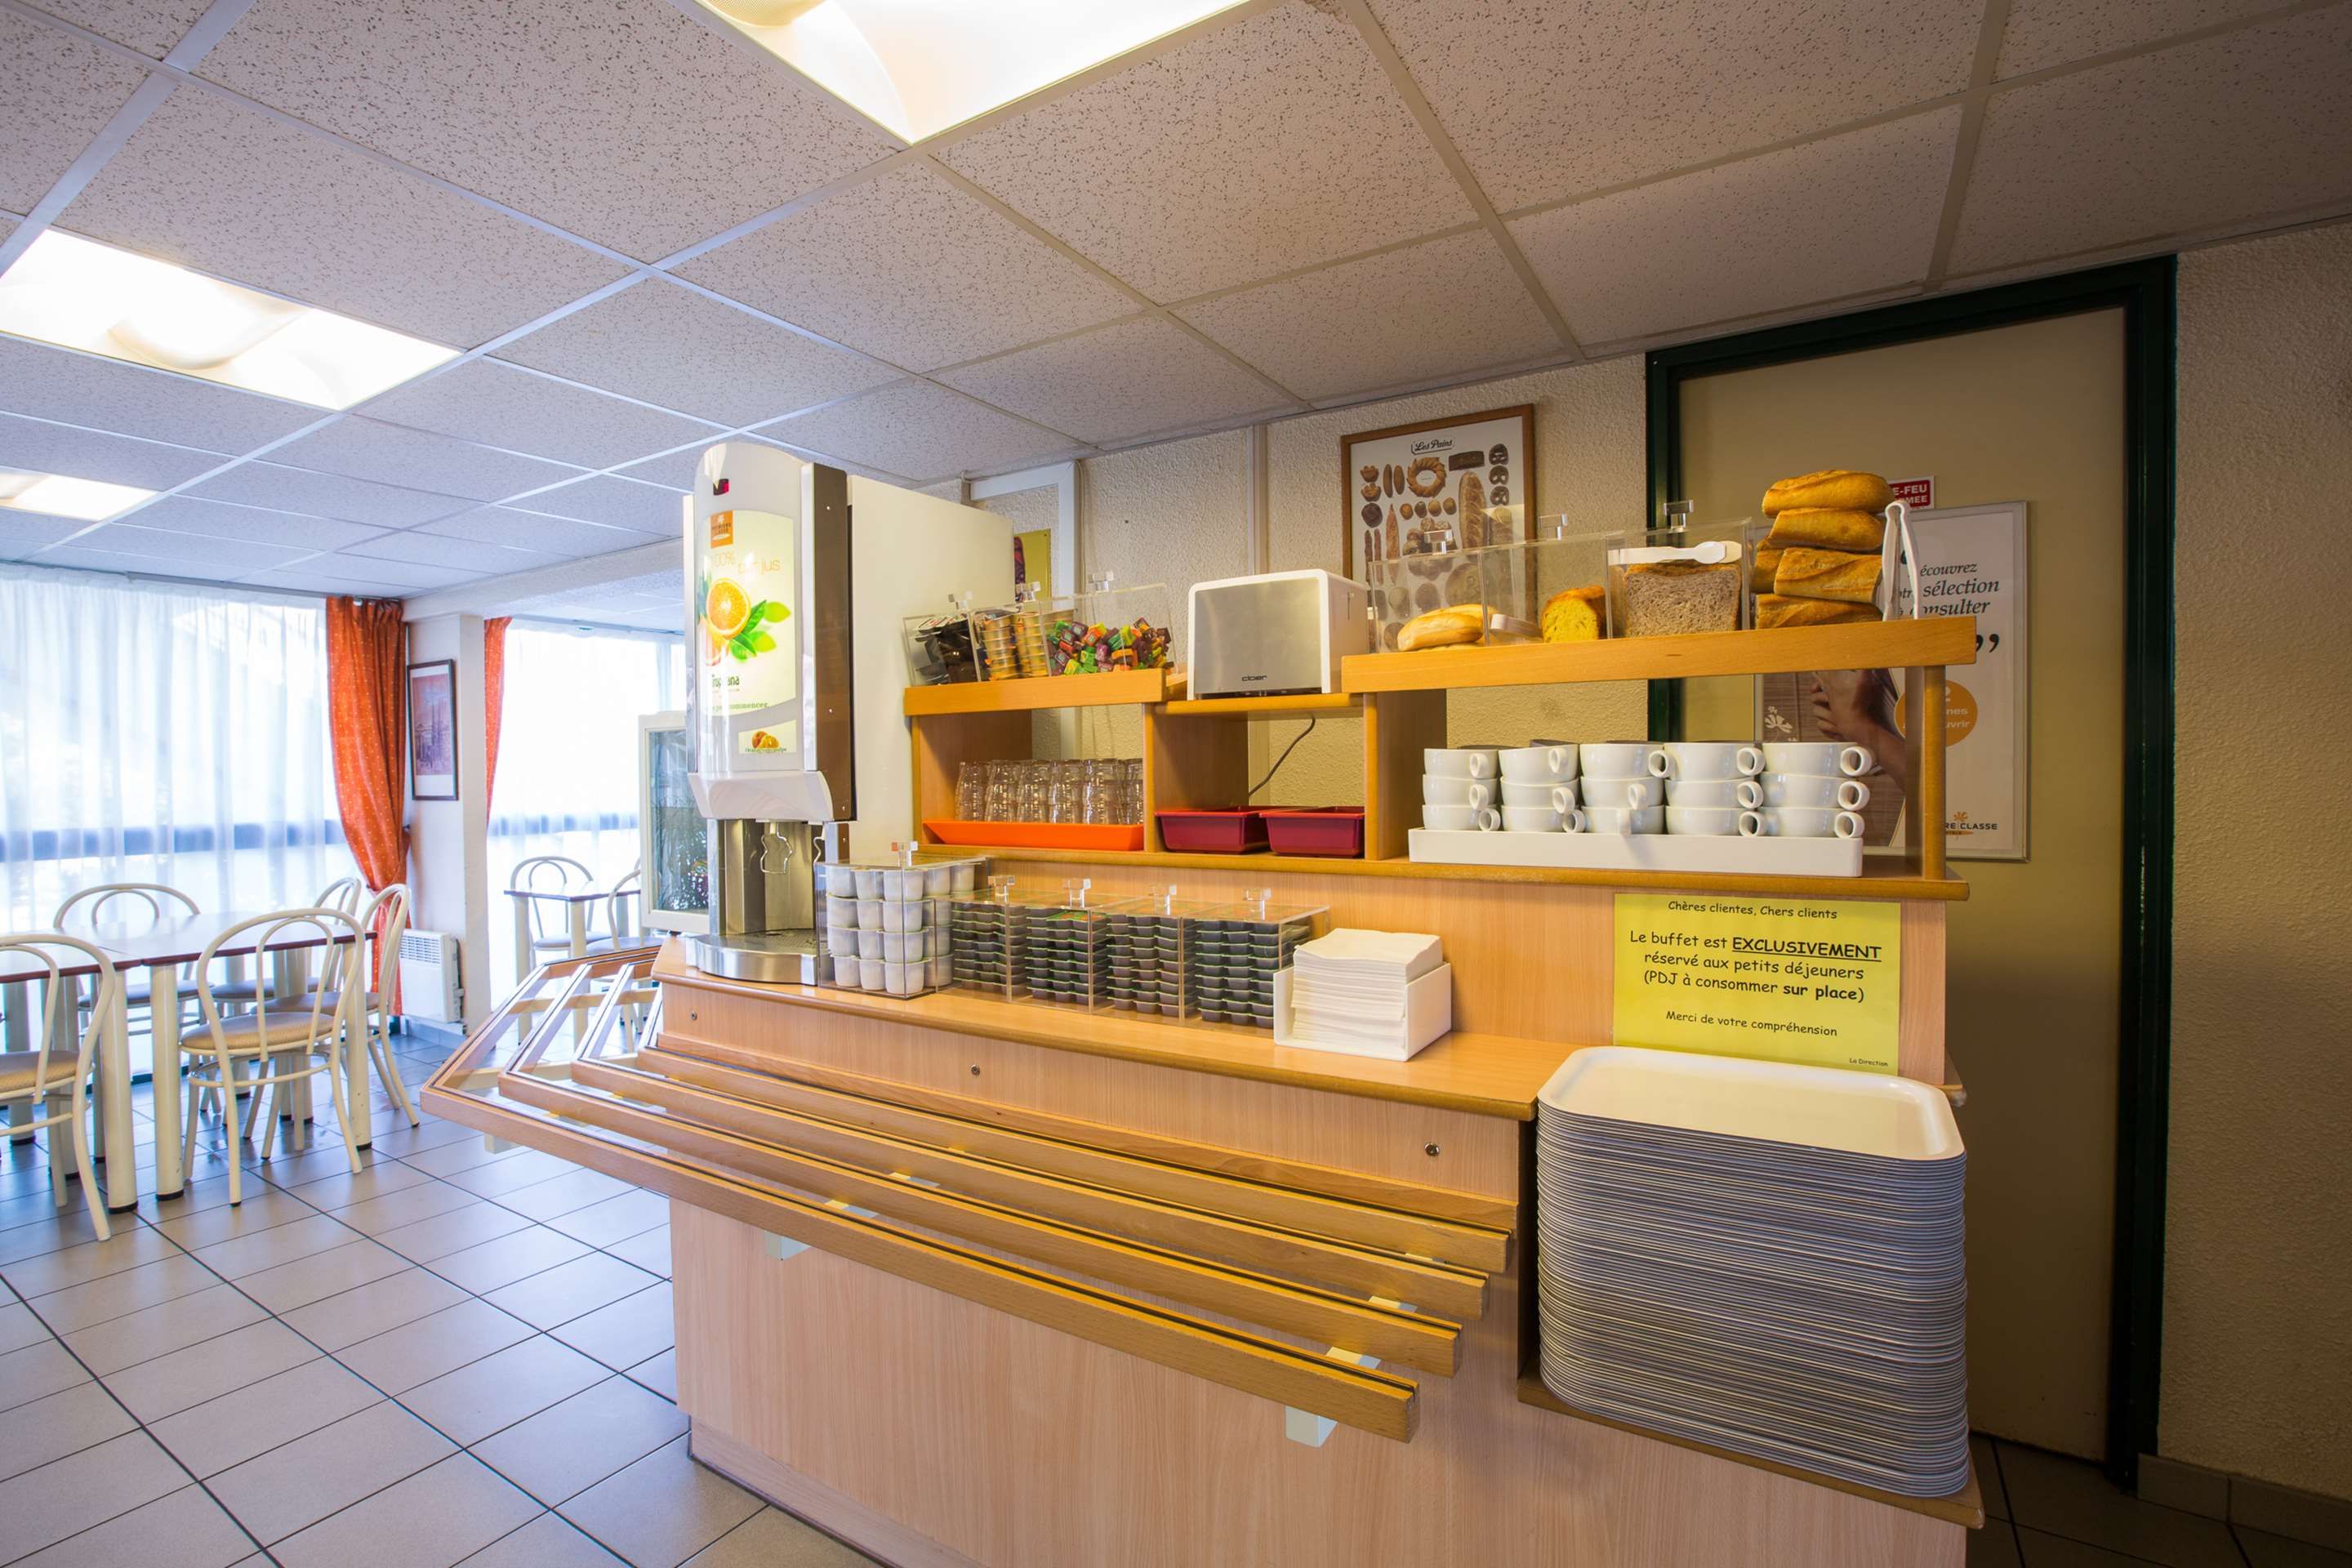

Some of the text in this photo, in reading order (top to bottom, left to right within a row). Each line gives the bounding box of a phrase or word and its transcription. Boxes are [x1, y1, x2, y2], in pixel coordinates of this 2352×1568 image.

[1920, 564, 1977, 577] écouvrez
[1922, 578, 1999, 597] sélection
[1909, 599, 1990, 616] nsulter
[1668, 901, 1838, 919] Chères clientes, Chers clients
[1630, 930, 1882, 960] Le buffet est EXCLUSIVEMENT
[1645, 951, 1864, 979] réservé aux petits déjeuners
[1644, 970, 1864, 1003] (PDJ à consommer sur place)
[1666, 1010, 1838, 1036] Merci de votre compréhension
[1859, 1058, 1888, 1067] Direction
